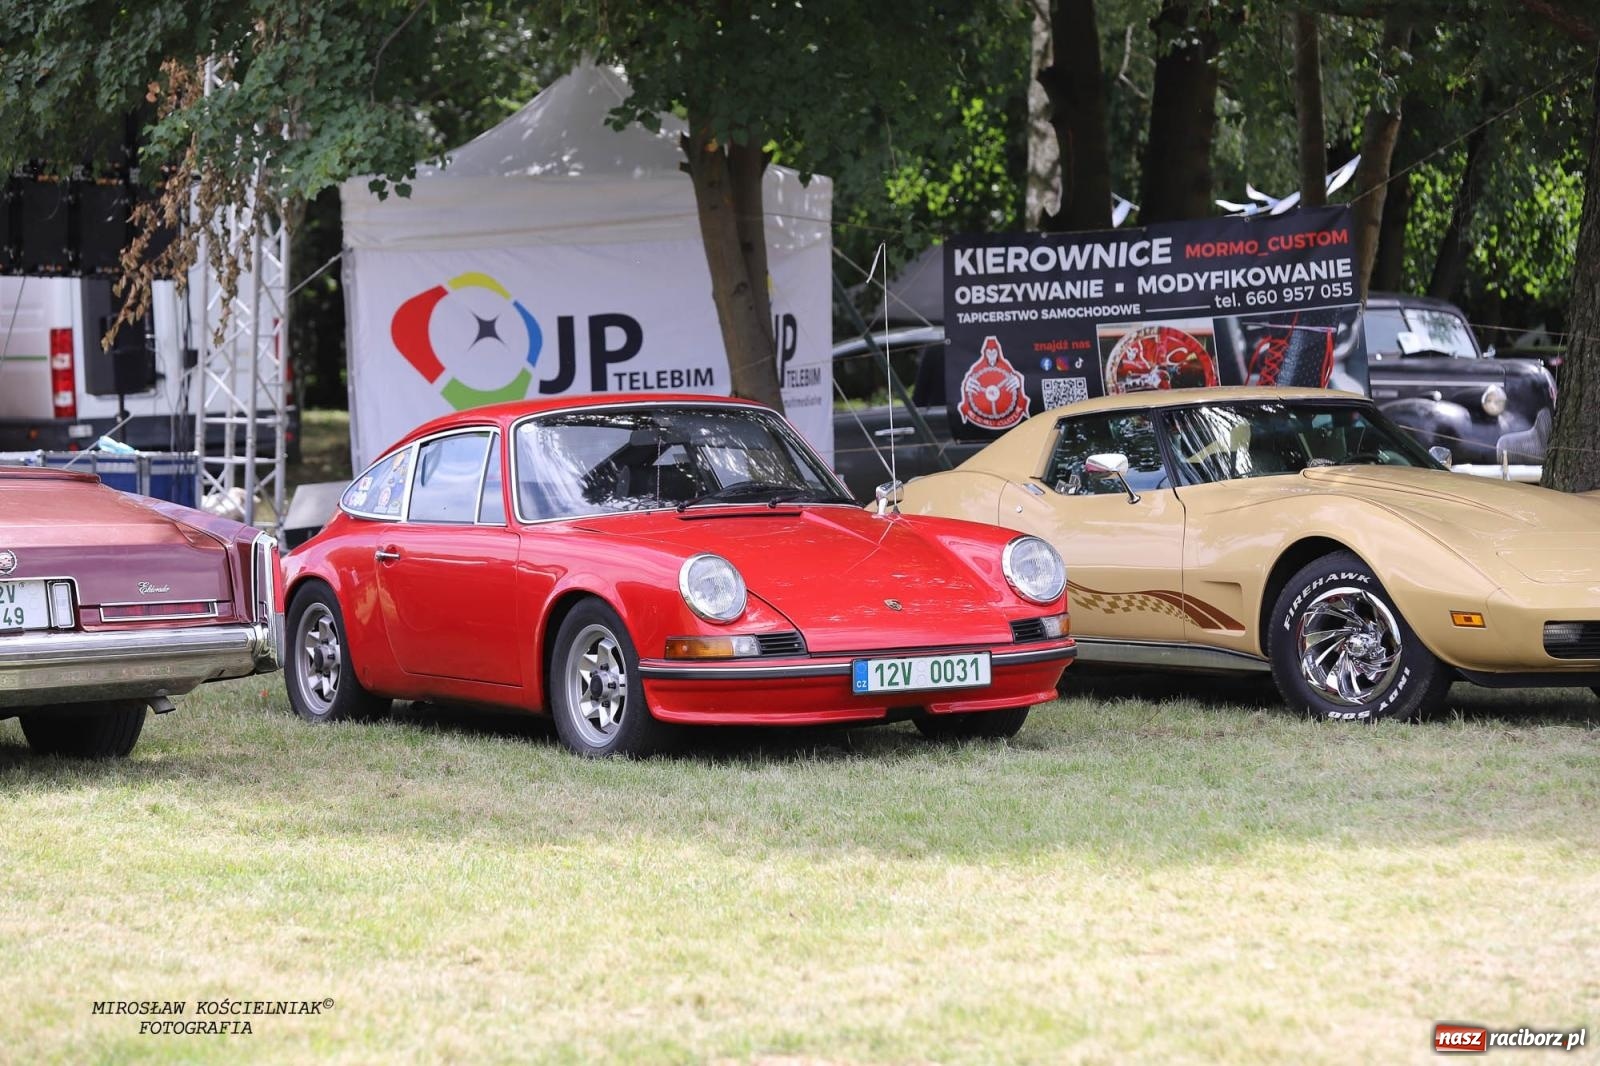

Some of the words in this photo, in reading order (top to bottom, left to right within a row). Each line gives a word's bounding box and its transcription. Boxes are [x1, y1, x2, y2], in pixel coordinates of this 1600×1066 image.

[954, 237, 1172, 276] KIEROWNICE
[1185, 229, 1349, 259] MORMO_CUSTOM
[954, 279, 1104, 305] OBSZYWANIE
[1137, 258, 1353, 295] MODYFIKOWANIE
[1214, 292, 1241, 308] tel.
[1245, 289, 1278, 306] 660
[1283, 285, 1315, 302] 957
[1320, 282, 1353, 298] 055
[957, 309, 1038, 324] TAPICERSTWO
[1041, 303, 1141, 320] SAMOCHODOWE
[538, 313, 643, 394] JP
[1071, 340, 1092, 350] nas
[613, 367, 714, 391] TELEBIM
[787, 367, 822, 388] TELEBIM
[1283, 572, 1371, 631] FIREHAWK
[3, 607, 24, 625] 49
[856, 680, 867, 688] CZ
[875, 661, 912, 687] 12V
[930, 657, 980, 684] 0031
[1378, 666, 1411, 712] INDY
